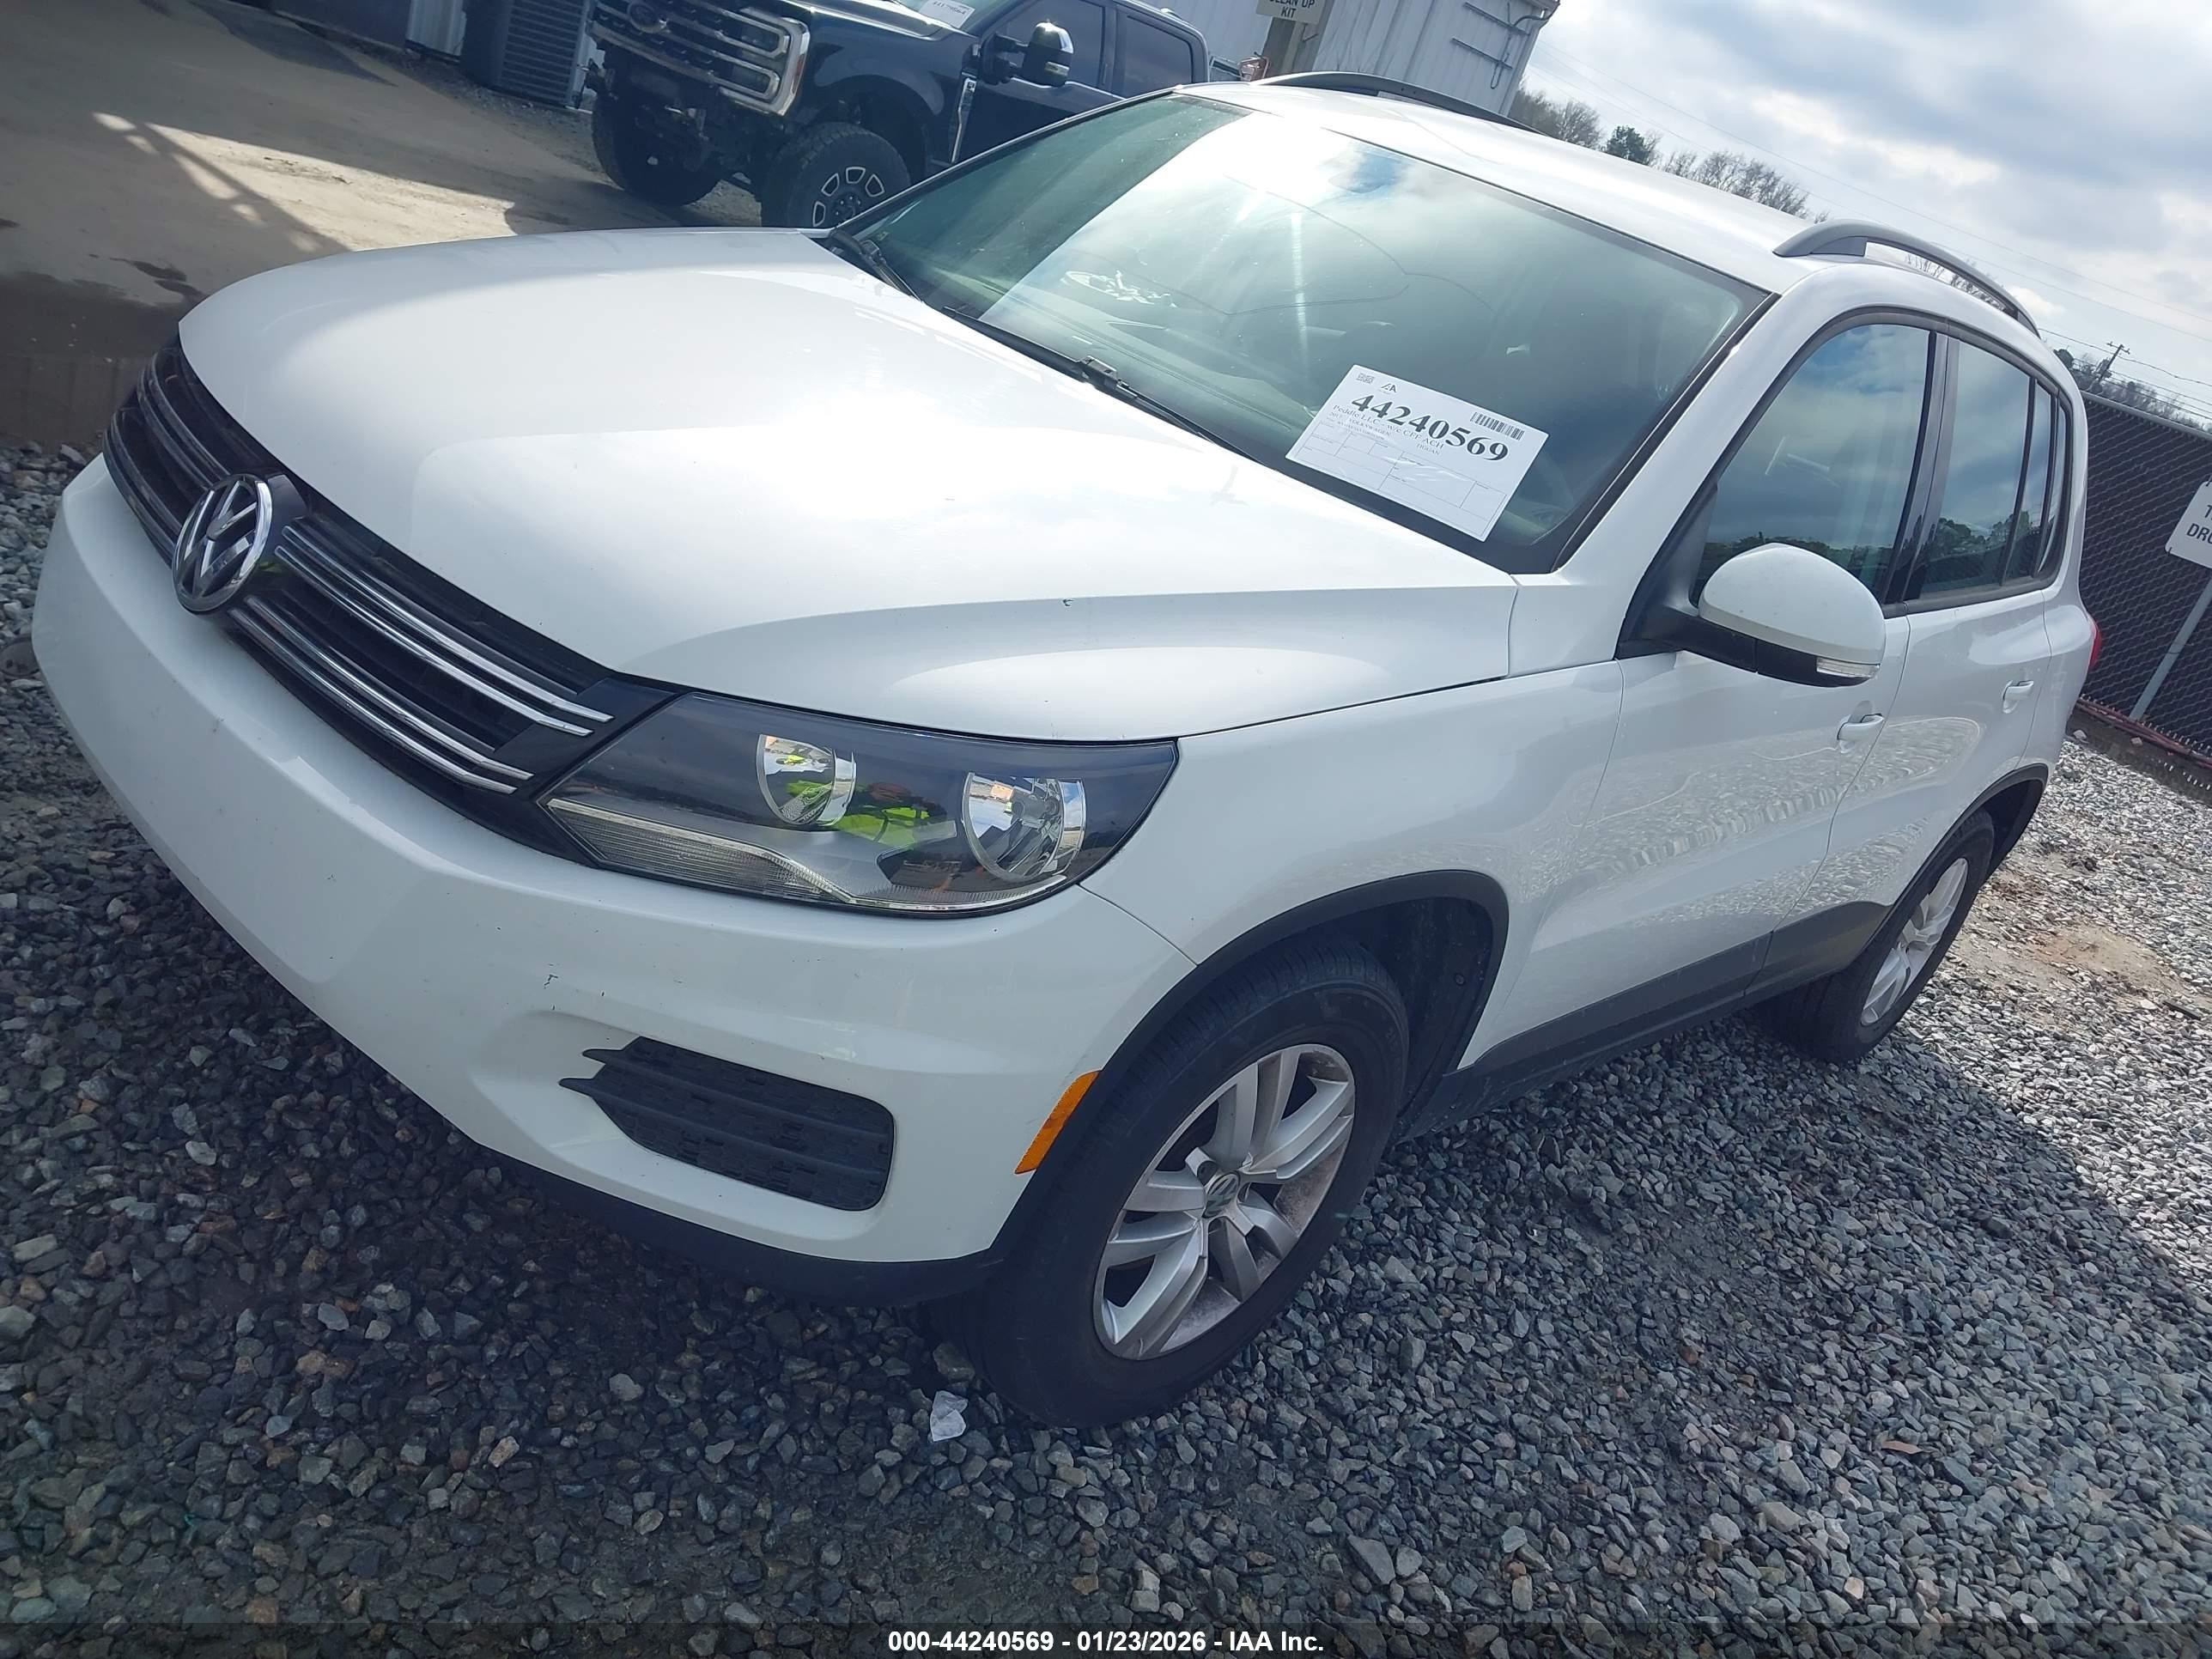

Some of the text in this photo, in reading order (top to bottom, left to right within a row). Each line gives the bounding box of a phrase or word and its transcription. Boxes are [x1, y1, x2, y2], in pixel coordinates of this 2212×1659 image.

[1280, 6, 1297, 18] KIT
[1333, 404, 1360, 418] Peddle
[1360, 414, 1381, 425] LLC
[1352, 395, 1509, 461] 44240569
